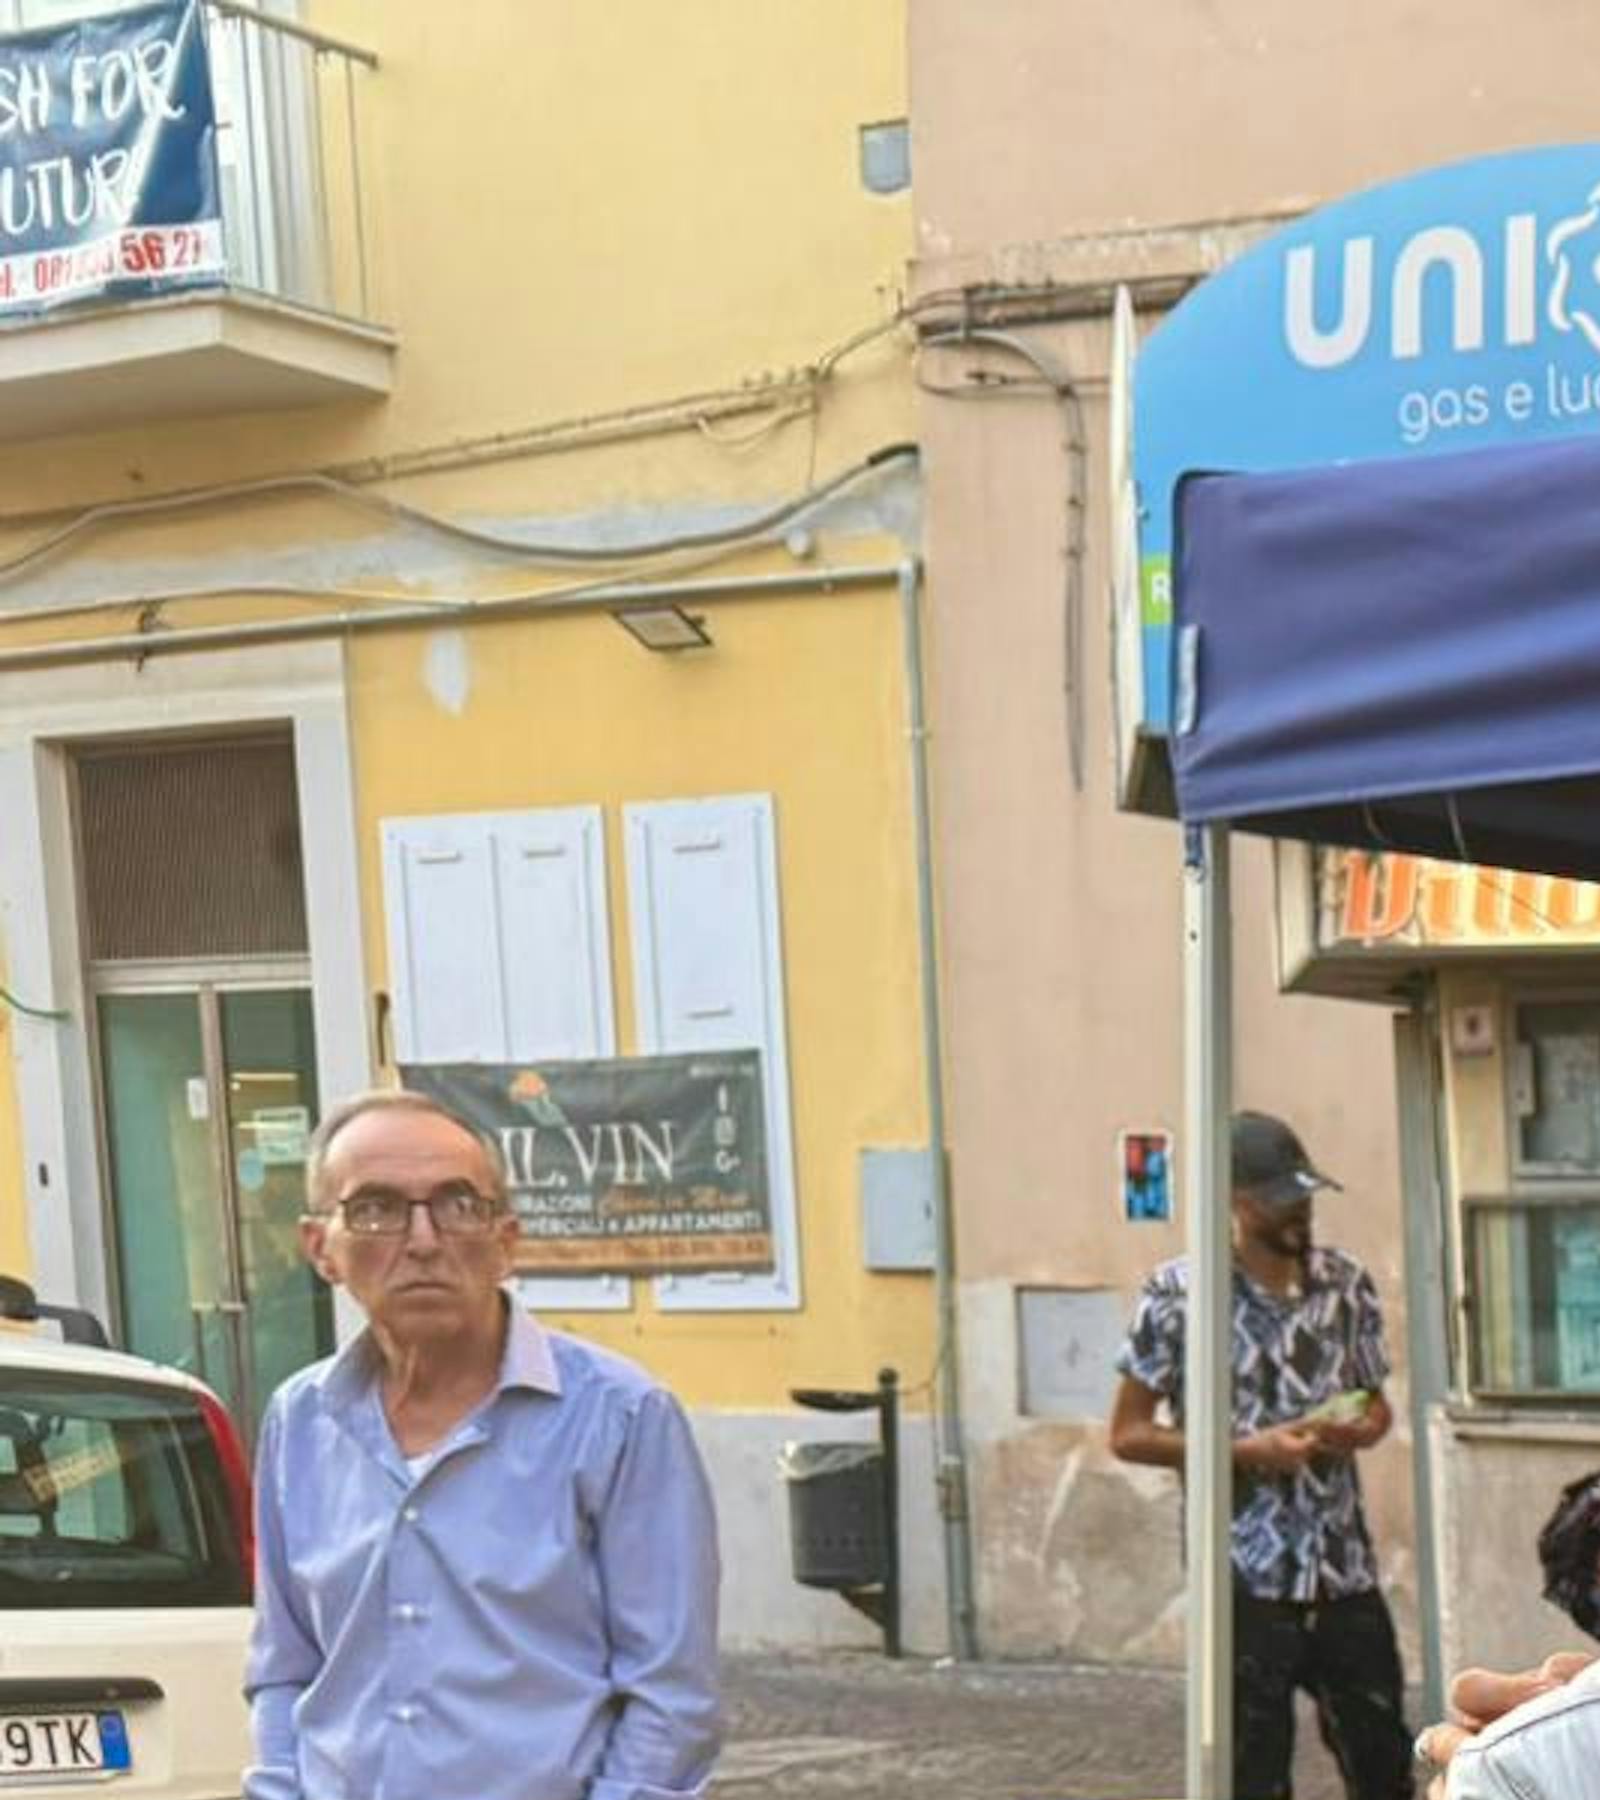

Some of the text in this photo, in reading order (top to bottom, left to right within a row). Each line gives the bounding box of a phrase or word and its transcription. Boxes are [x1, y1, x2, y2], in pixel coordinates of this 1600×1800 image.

[71, 39, 187, 122] FOR
[1, 147, 133, 235] UTUR
[1400, 383, 1490, 442] gas
[1506, 381, 1534, 419] e
[501, 1121, 676, 1188] IL.VIN
[0, 1717, 97, 1766] 9TK
